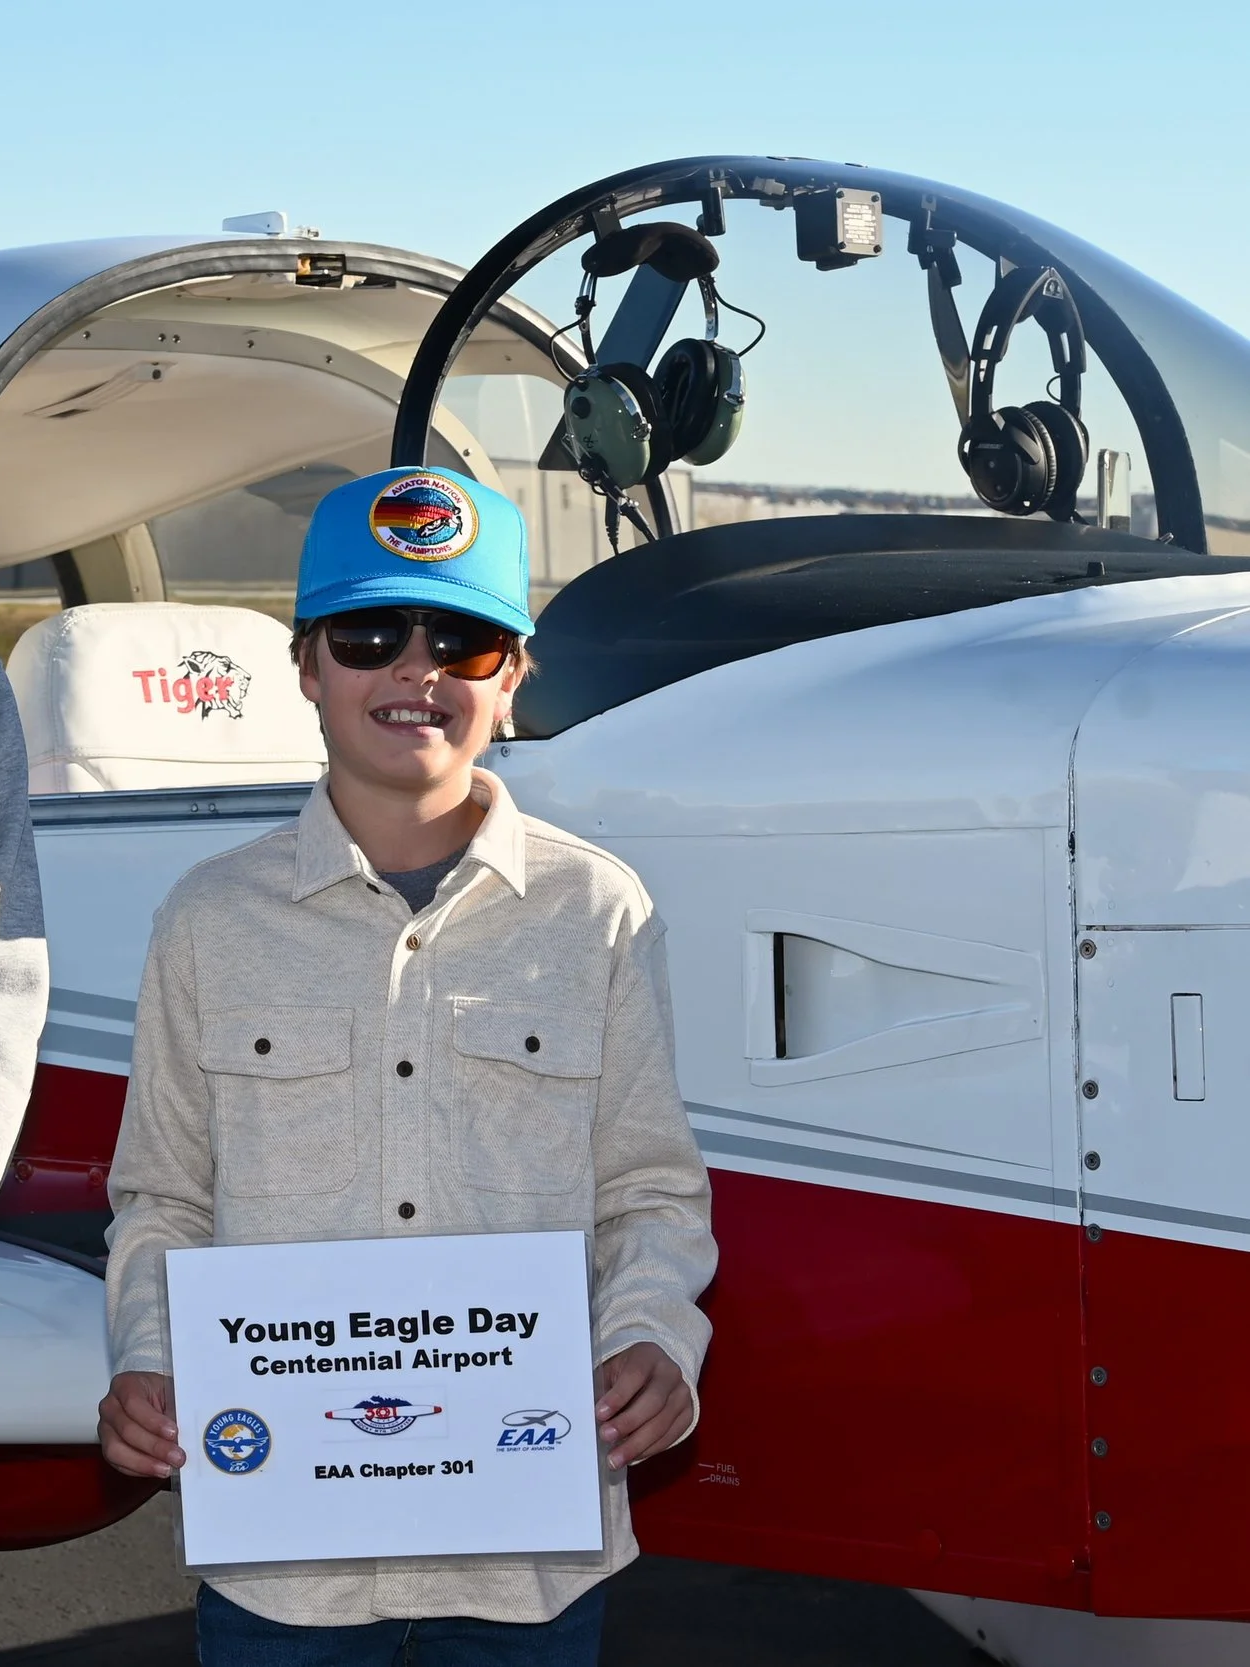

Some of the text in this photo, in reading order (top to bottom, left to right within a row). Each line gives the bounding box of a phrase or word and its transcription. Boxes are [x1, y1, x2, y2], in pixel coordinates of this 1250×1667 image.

[391, 479, 463, 504] AVIATOR NATION
[386, 535, 452, 555] THE HAMPTONS
[132, 667, 234, 714] Tiger
[220, 1307, 539, 1346] Young Eagle Day
[250, 1347, 513, 1376] Centennial Airport
[209, 1413, 264, 1435] YOUNG EAGLES
[497, 1428, 556, 1446] EAA
[314, 1460, 474, 1480] EAA Chapter 301
[716, 1463, 737, 1474] FUEL
[710, 1473, 740, 1487] DRAINS
